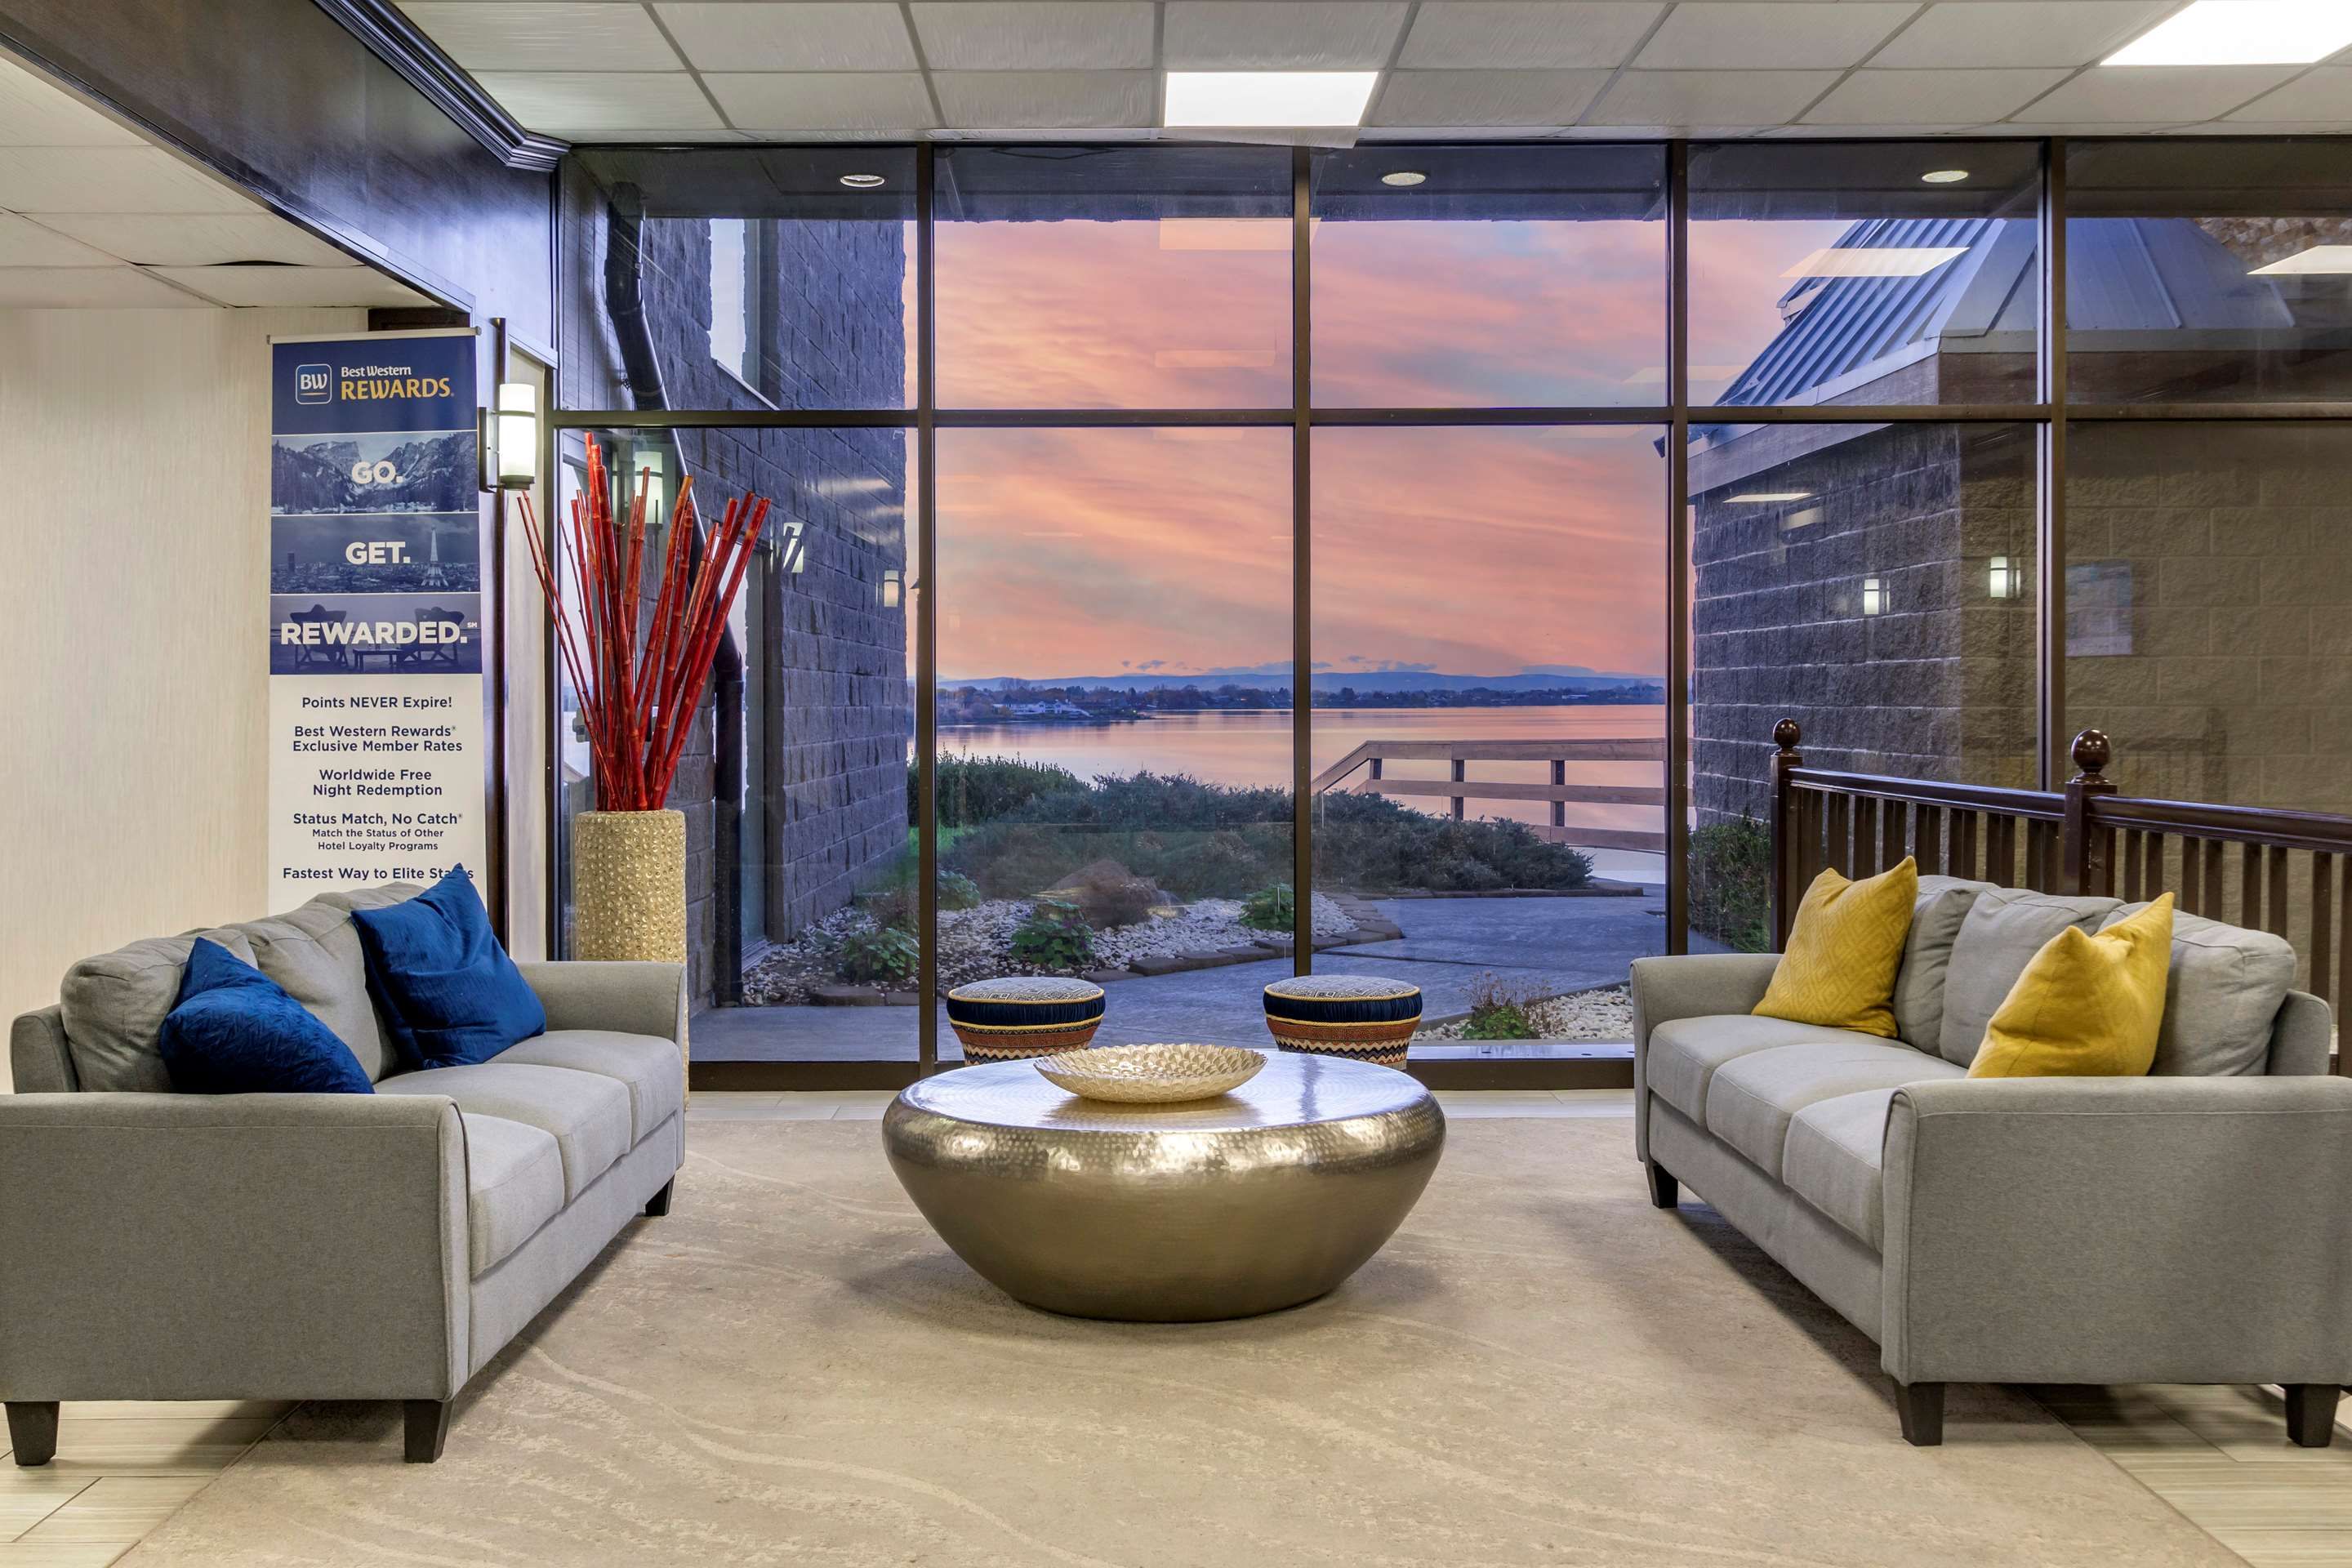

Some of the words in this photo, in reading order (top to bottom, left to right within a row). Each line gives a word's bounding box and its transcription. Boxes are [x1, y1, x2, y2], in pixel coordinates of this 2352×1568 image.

[341, 367, 365, 377] Best
[367, 366, 412, 376] Western
[301, 374, 327, 390] BW
[341, 377, 451, 400] REWARDS
[351, 461, 403, 484] GO.
[345, 541, 411, 564] GET.
[281, 621, 467, 645] REWARDED.
[302, 697, 345, 708] Points
[350, 697, 398, 708] NEVER
[403, 696, 452, 710] Expire!
[295, 726, 324, 737] Best
[329, 726, 386, 737] Western
[293, 741, 358, 751] Exclusive
[363, 741, 418, 751] Member
[424, 741, 462, 751] Rates
[319, 769, 395, 780] Worldwide
[400, 769, 431, 780] Free
[314, 784, 351, 797] Night
[357, 784, 442, 797] Redemption
[293, 813, 336, 825] Status
[342, 813, 387, 826] Match,
[392, 813, 412, 824] No
[312, 829, 342, 837] Match
[346, 829, 363, 837] the
[367, 829, 397, 837] Status
[400, 829, 411, 837] of
[414, 829, 443, 837] Other
[318, 842, 345, 850] Hotel
[349, 842, 385, 851] Loyalty
[389, 842, 438, 851] Programs
[283, 868, 333, 879] Fastest
[338, 868, 369, 880] Way
[374, 869, 387, 879] to
[393, 867, 424, 879] Elite
[430, 868, 474, 879] Sts
